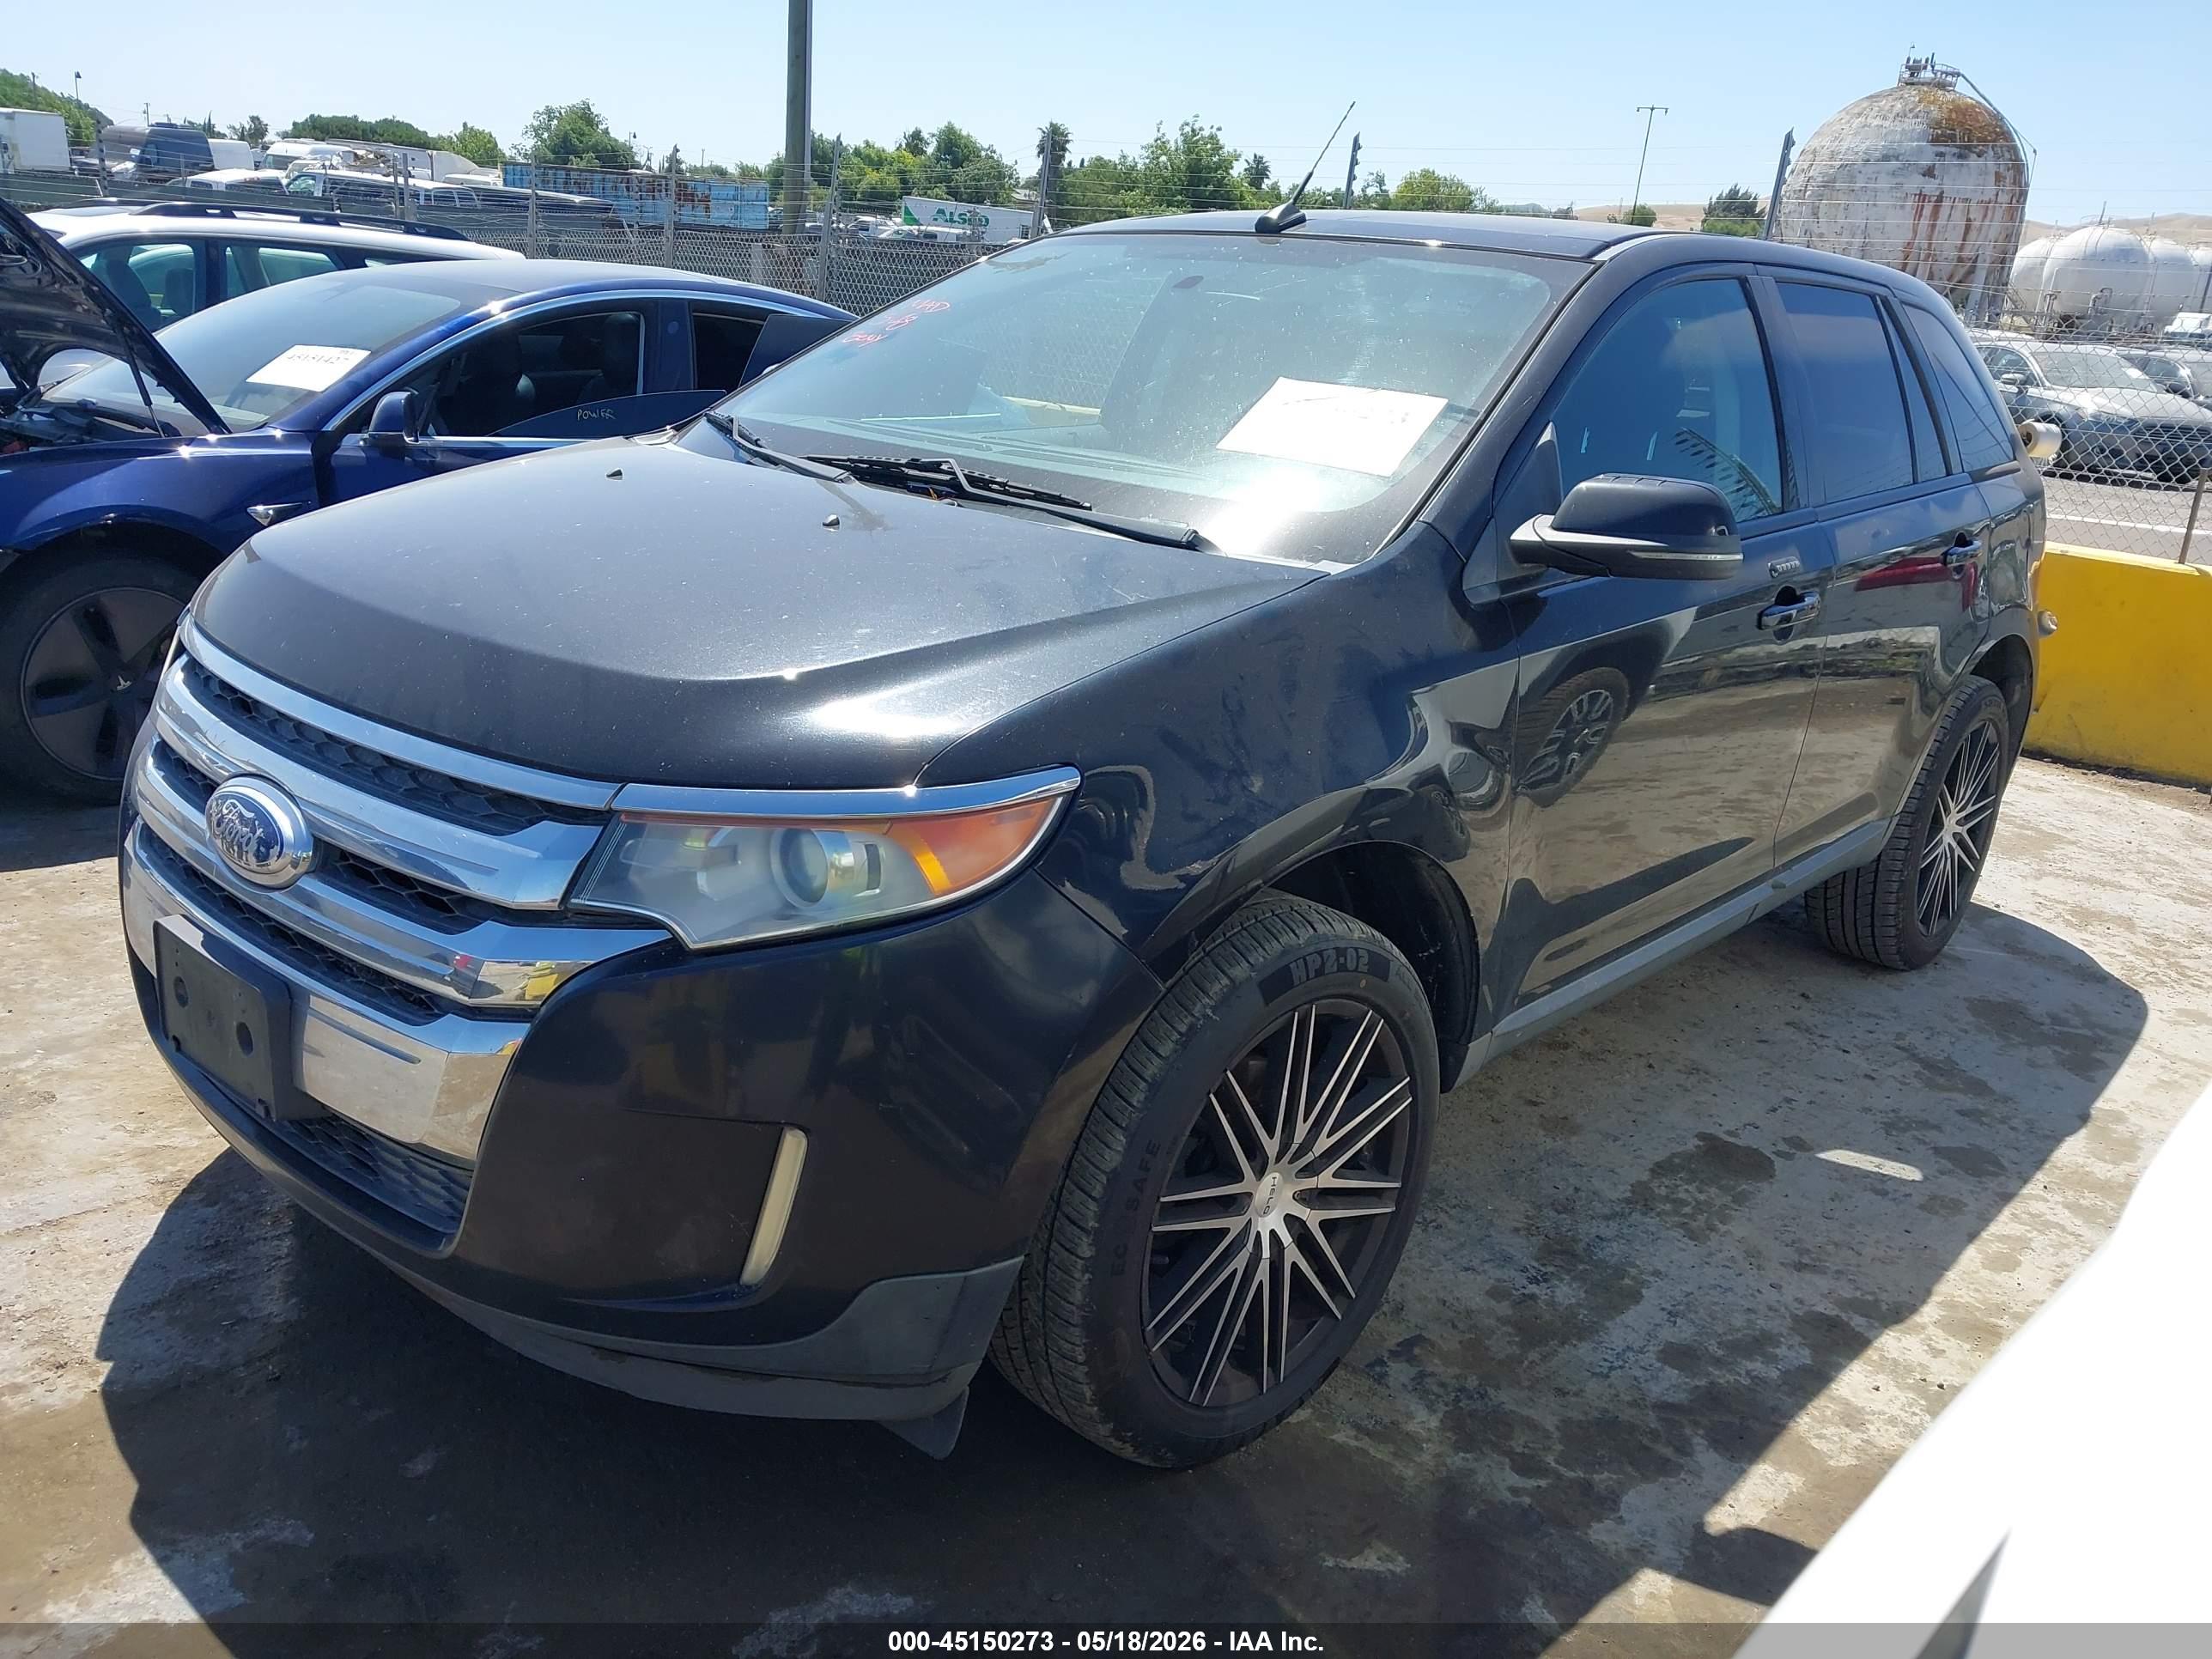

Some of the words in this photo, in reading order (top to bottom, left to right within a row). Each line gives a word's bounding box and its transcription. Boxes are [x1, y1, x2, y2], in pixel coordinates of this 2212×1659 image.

[577, 408, 617, 422] POWER
[211, 799, 264, 857] Ford
[1262, 1176, 1278, 1215] HELO
